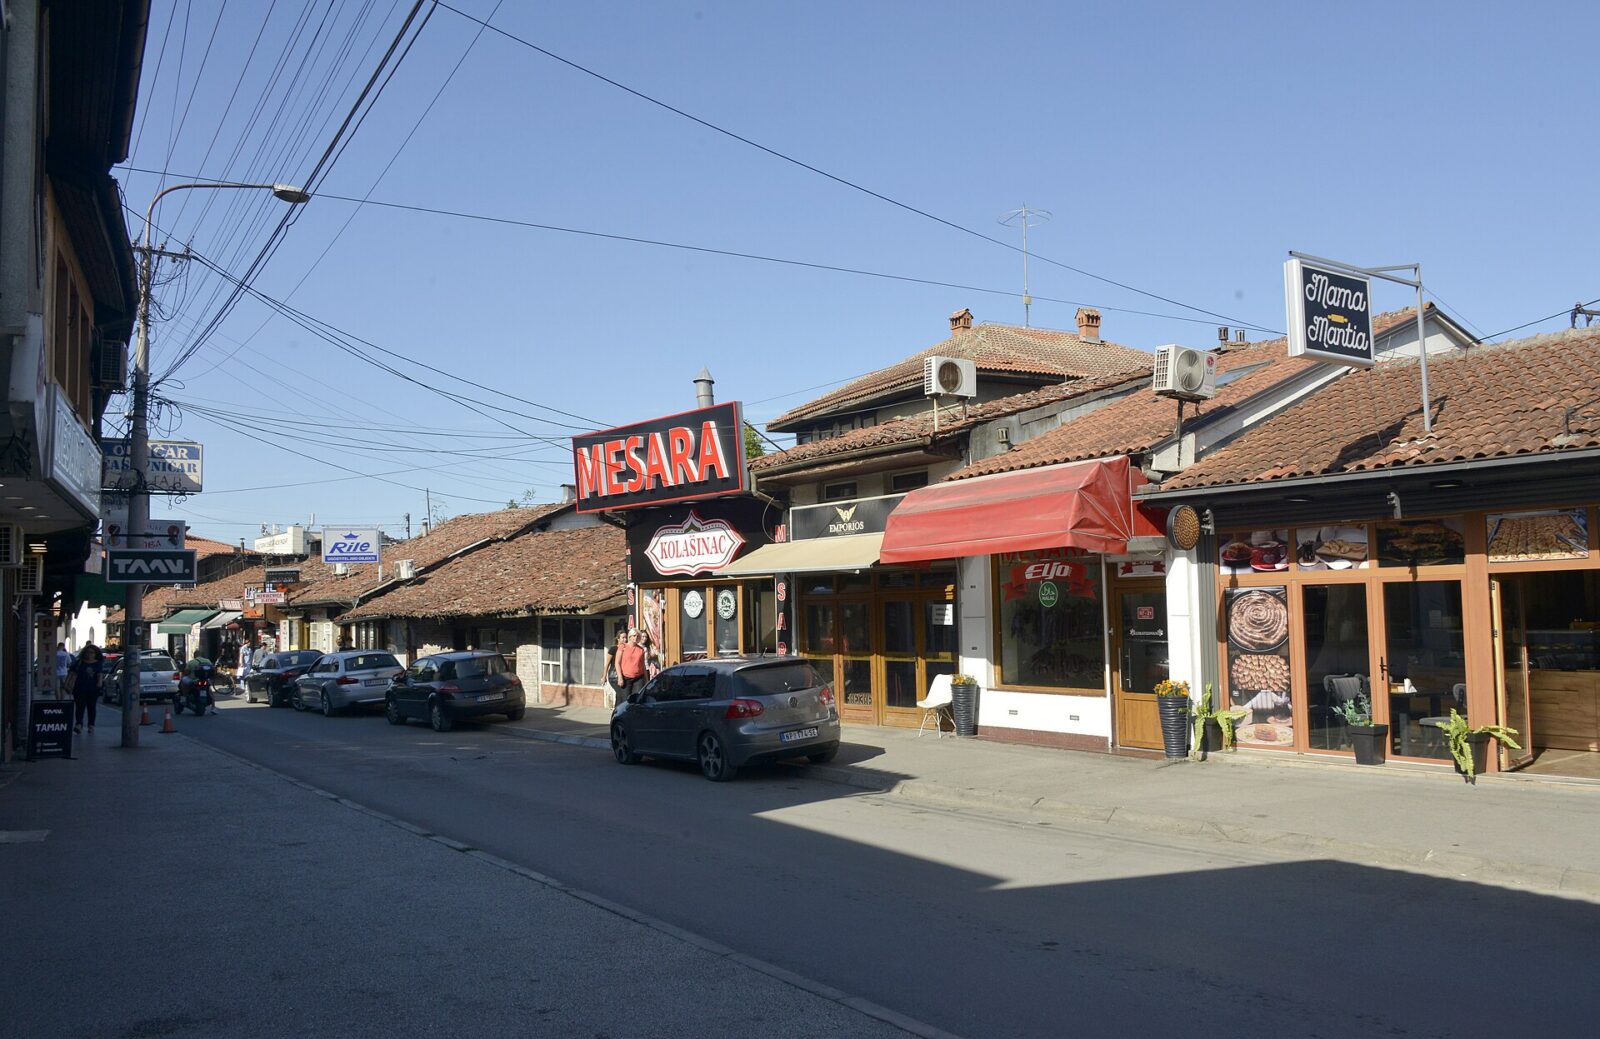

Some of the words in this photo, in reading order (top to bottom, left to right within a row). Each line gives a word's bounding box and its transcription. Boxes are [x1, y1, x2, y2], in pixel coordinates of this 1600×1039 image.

[1305, 273, 1366, 312] Mama
[1307, 315, 1369, 351] Mantia
[577, 420, 730, 499] MESARA
[829, 521, 864, 533] EMPORIOS
[329, 542, 370, 554] Rile
[660, 535, 726, 559] KOLAŠINAC
[35, 723, 68, 732] TAMAN
